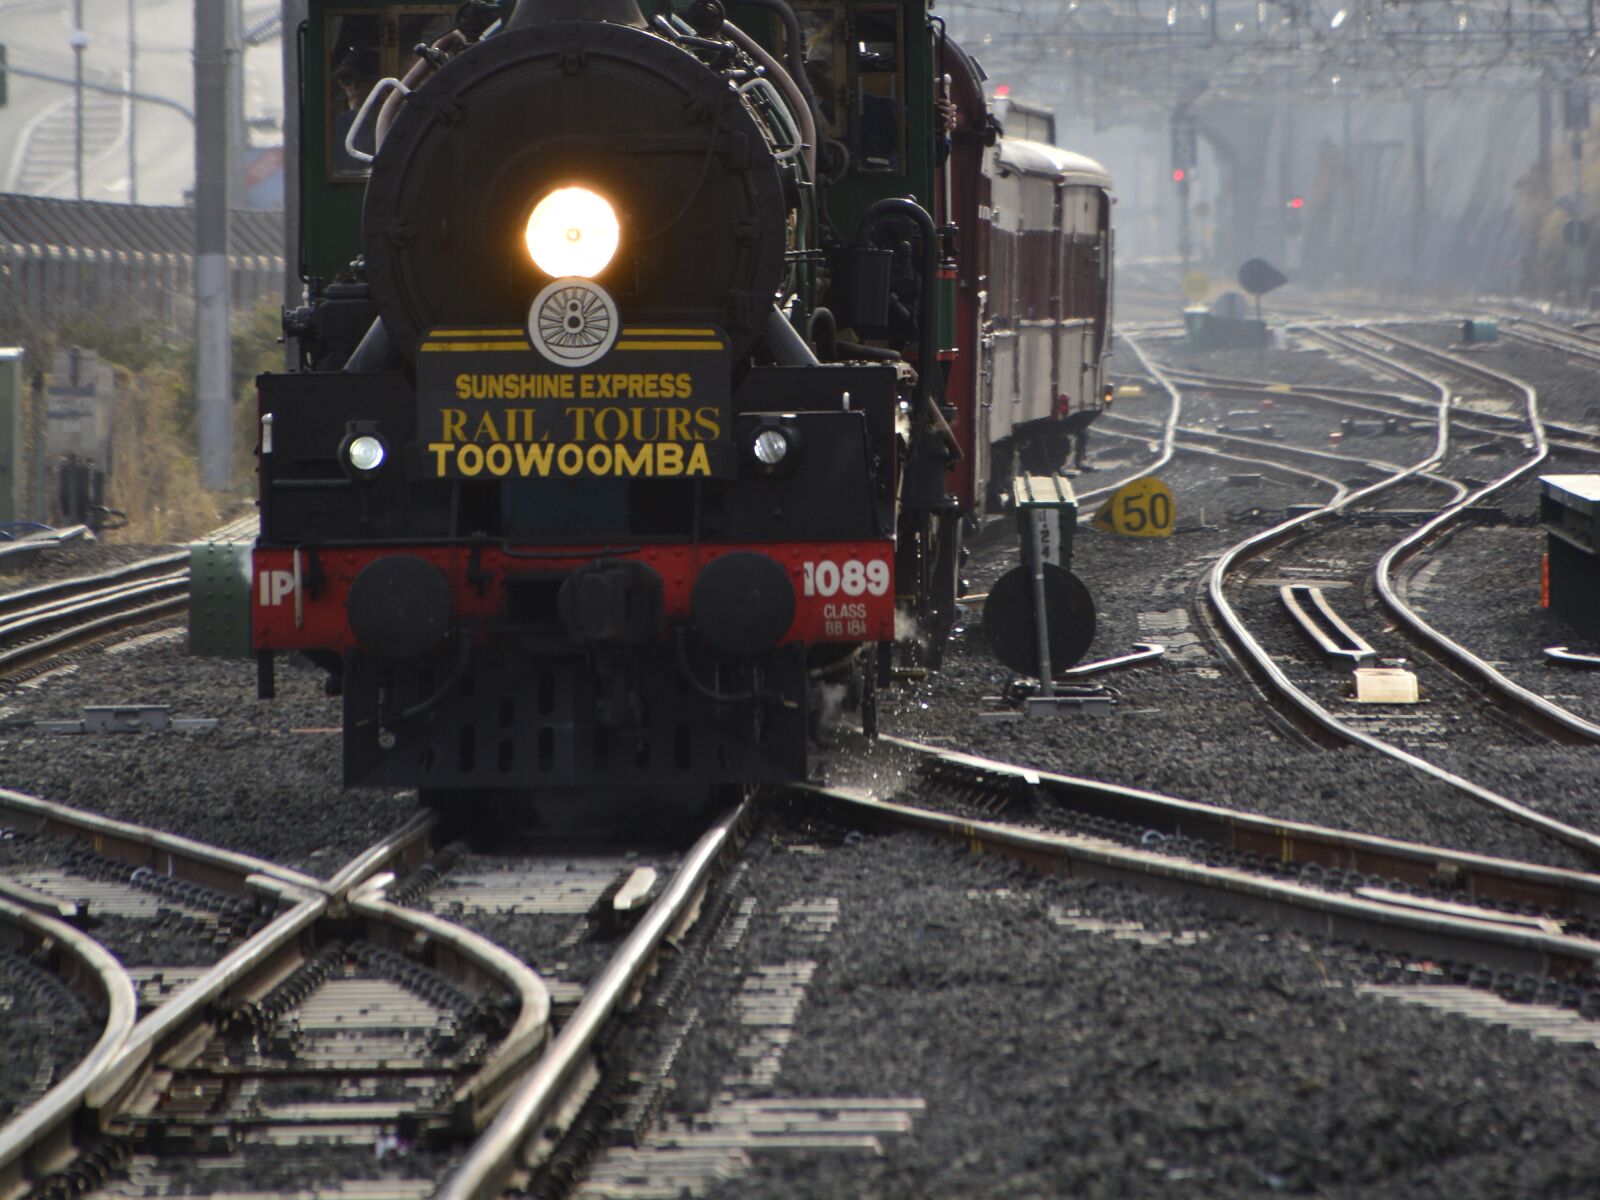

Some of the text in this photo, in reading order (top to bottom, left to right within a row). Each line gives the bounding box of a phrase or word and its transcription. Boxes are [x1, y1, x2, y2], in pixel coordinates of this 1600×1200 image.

[455, 373, 692, 399] SUNSHINE EXPRESS
[439, 407, 720, 442] RAIL TOURS
[428, 442, 712, 477] TOOWOOMBA
[1123, 493, 1170, 532] 50
[803, 559, 890, 597] 1089
[824, 604, 867, 620] CLASS
[825, 620, 843, 636] BB
